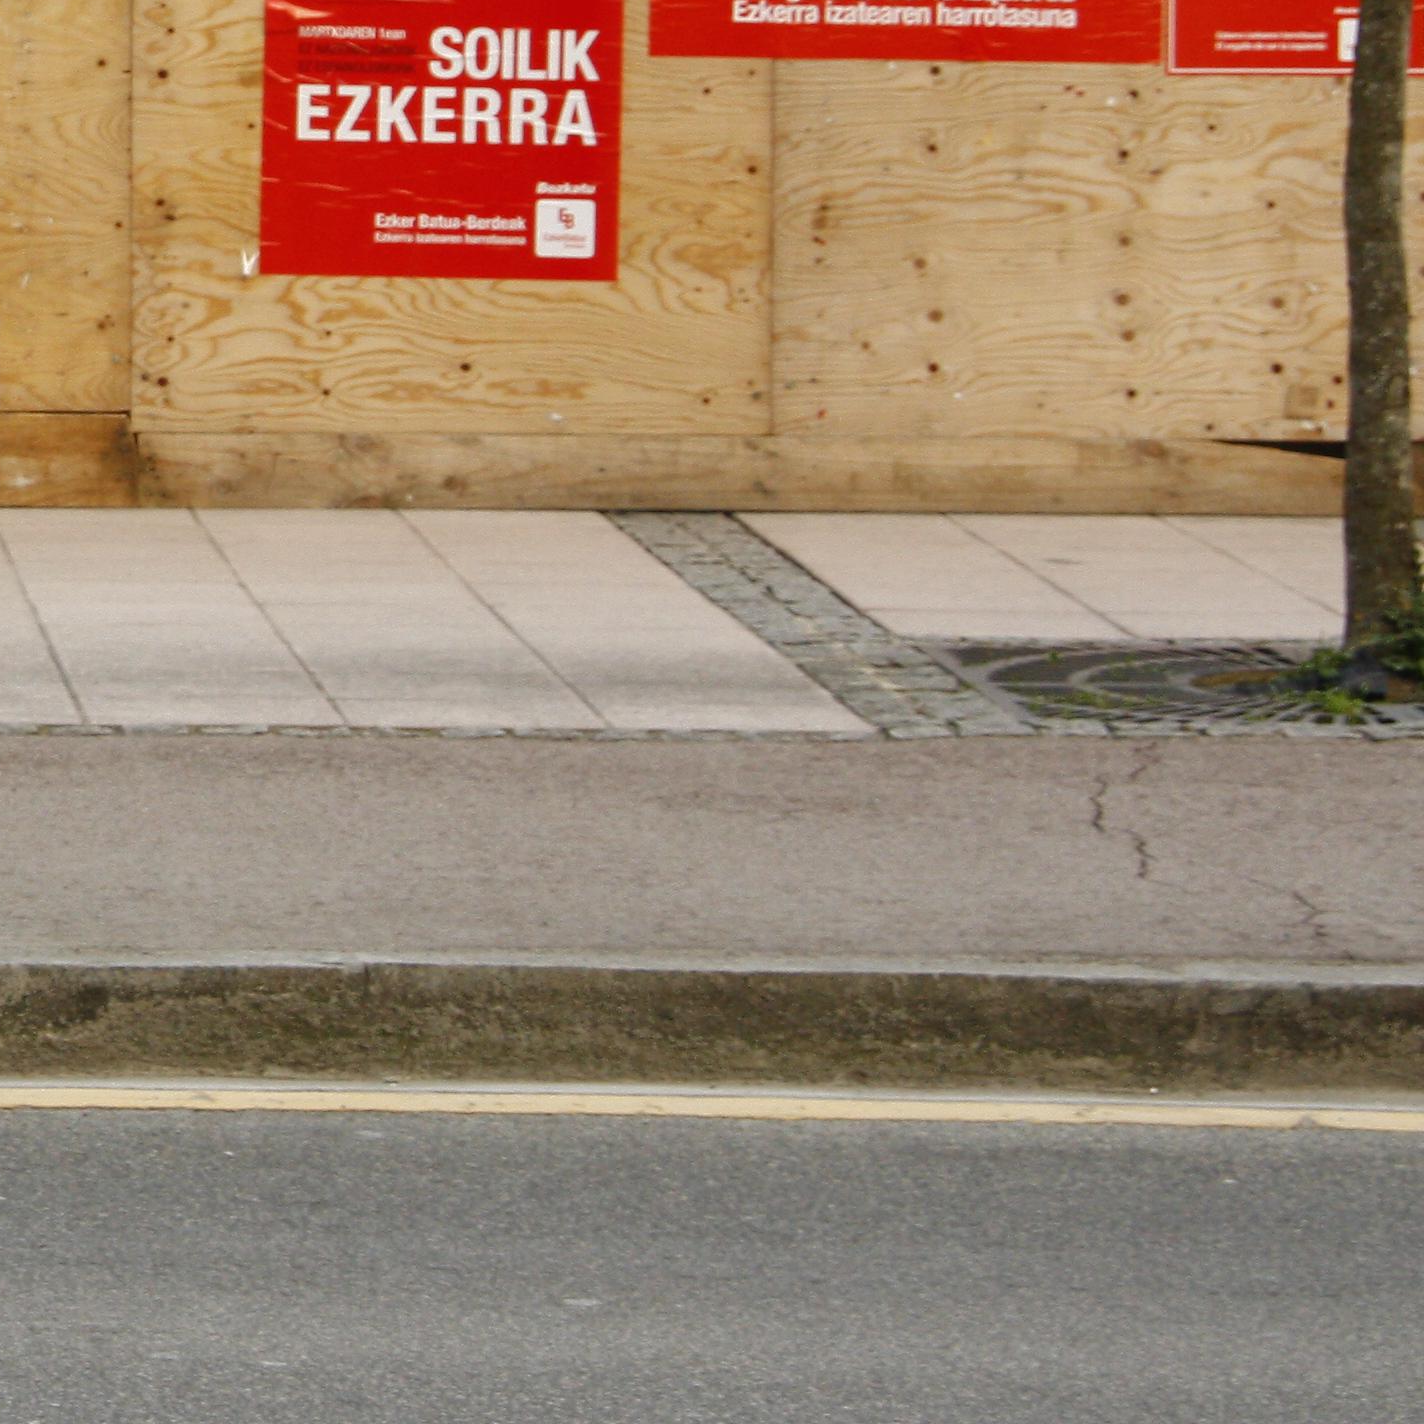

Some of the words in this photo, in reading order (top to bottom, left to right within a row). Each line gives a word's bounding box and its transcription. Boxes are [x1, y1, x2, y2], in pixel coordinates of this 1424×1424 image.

[732, 0, 819, 23] Ezkerra
[824, 0, 932, 26] izatearen
[935, 1, 1078, 28] harrotasuna
[427, 25, 601, 82] SOILIK
[295, 83, 598, 147] EZKERRA
